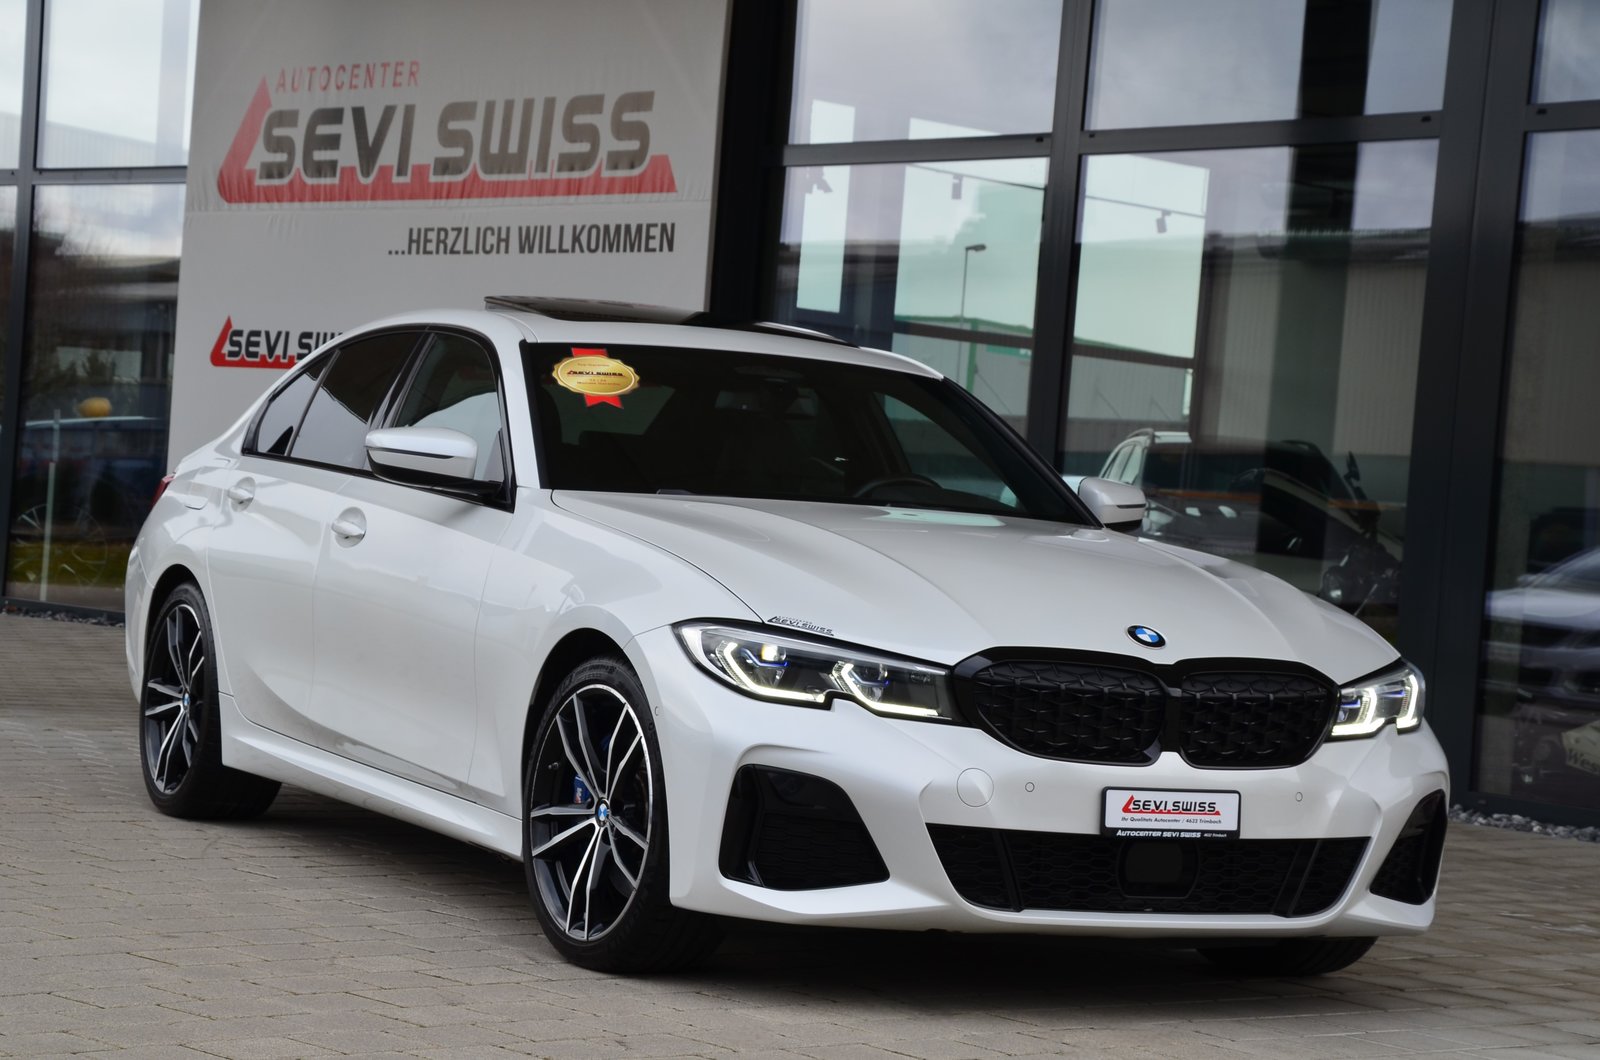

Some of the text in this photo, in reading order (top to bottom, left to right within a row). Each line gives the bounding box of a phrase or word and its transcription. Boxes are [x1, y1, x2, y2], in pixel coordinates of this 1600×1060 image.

[275, 59, 420, 93] AUTOCENTER
[256, 90, 656, 181] SEVI SWISS
[387, 222, 676, 255] ...HERZLICH WILLKOMMEN
[226, 328, 290, 360] SEVI
[801, 623, 833, 634] SWISS
[1131, 799, 1217, 813] SEVI SWISS
[1116, 829, 1162, 837] AUTOCENTER
